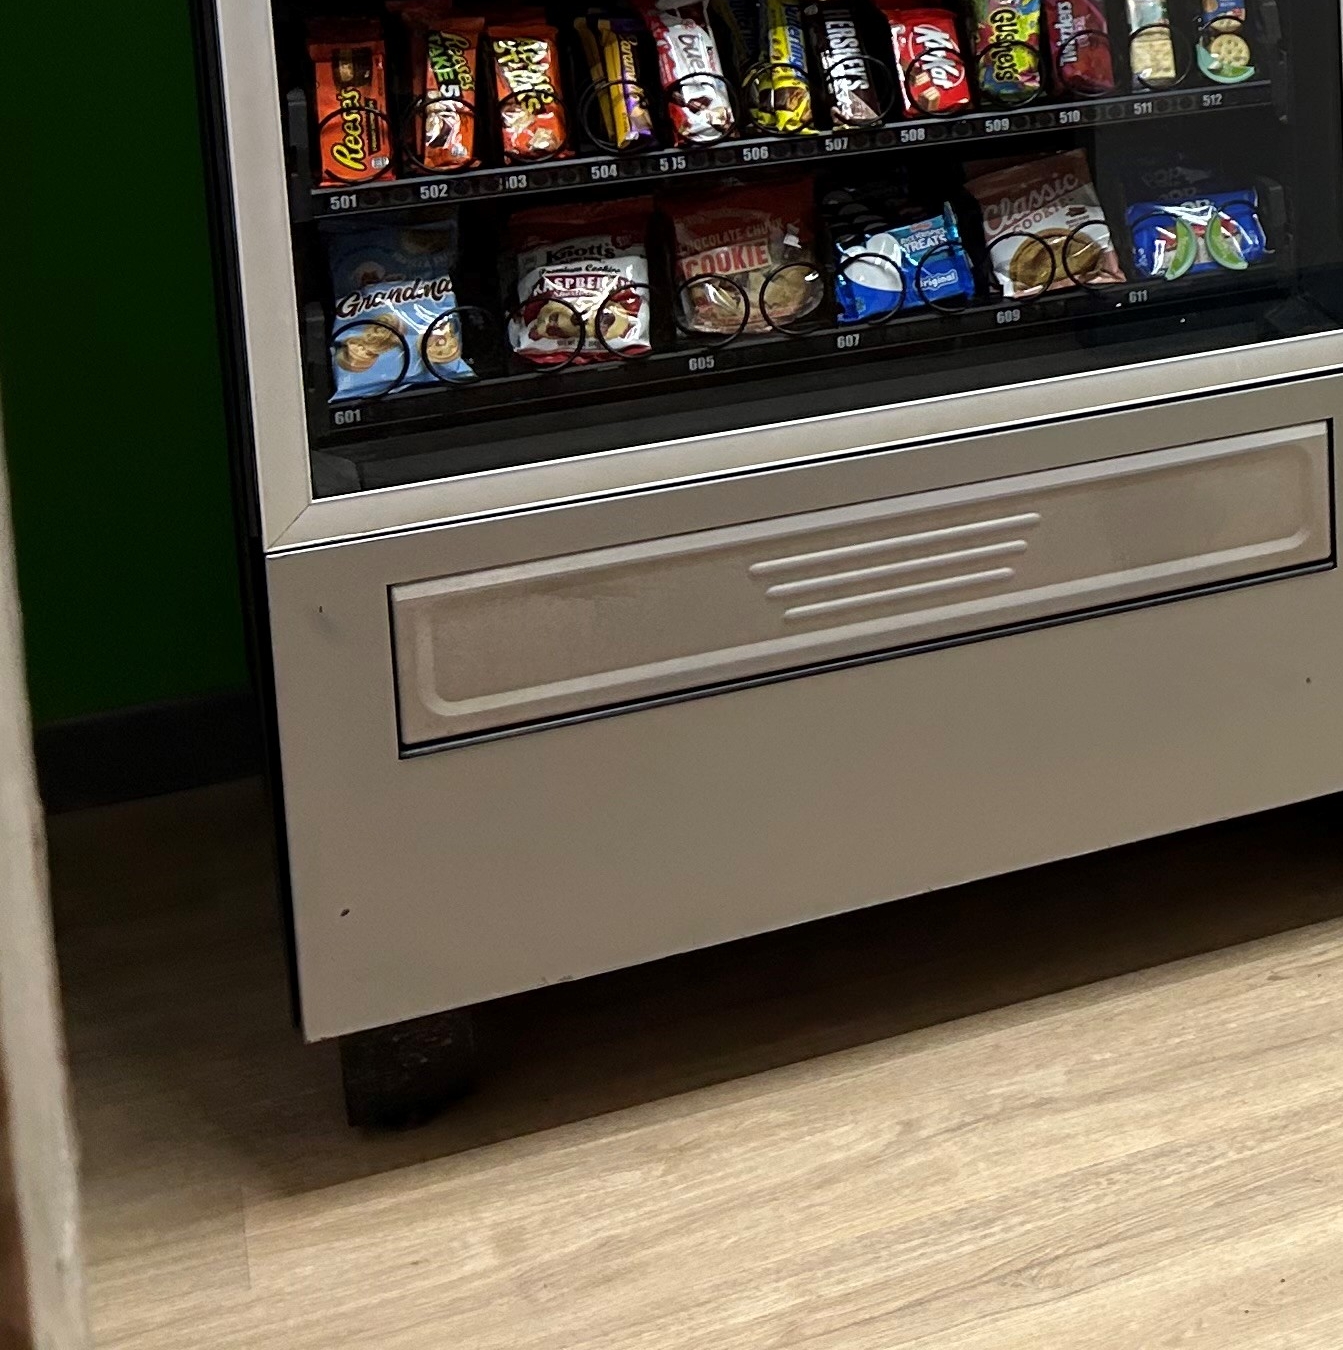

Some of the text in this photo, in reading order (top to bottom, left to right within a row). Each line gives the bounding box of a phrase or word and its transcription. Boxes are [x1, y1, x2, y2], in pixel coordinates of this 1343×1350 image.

[1056, 0, 1078, 67] Twizzlers
[678, 33, 706, 71] bue
[427, 30, 461, 100] TAKE 5
[1133, 101, 1153, 115] 511
[1202, 93, 1223, 107] 512
[1059, 109, 1081, 124] 510
[331, 85, 367, 172] Reese's
[985, 118, 1010, 133] 509
[900, 127, 926, 143] 508
[825, 137, 849, 152] 507
[742, 146, 769, 161] 506
[591, 164, 618, 179] 504
[420, 183, 448, 200] 502
[330, 194, 357, 210] 501
[983, 171, 1080, 237] Classic
[902, 233, 948, 254] TREATS
[546, 242, 616, 266] Knott's
[683, 243, 770, 279] COOKIE
[917, 270, 957, 288] riginal
[1128, 289, 1148, 303] 611
[996, 309, 1021, 324] 609
[837, 333, 860, 349] 607
[688, 355, 715, 371] 605
[334, 409, 361, 425] 601
